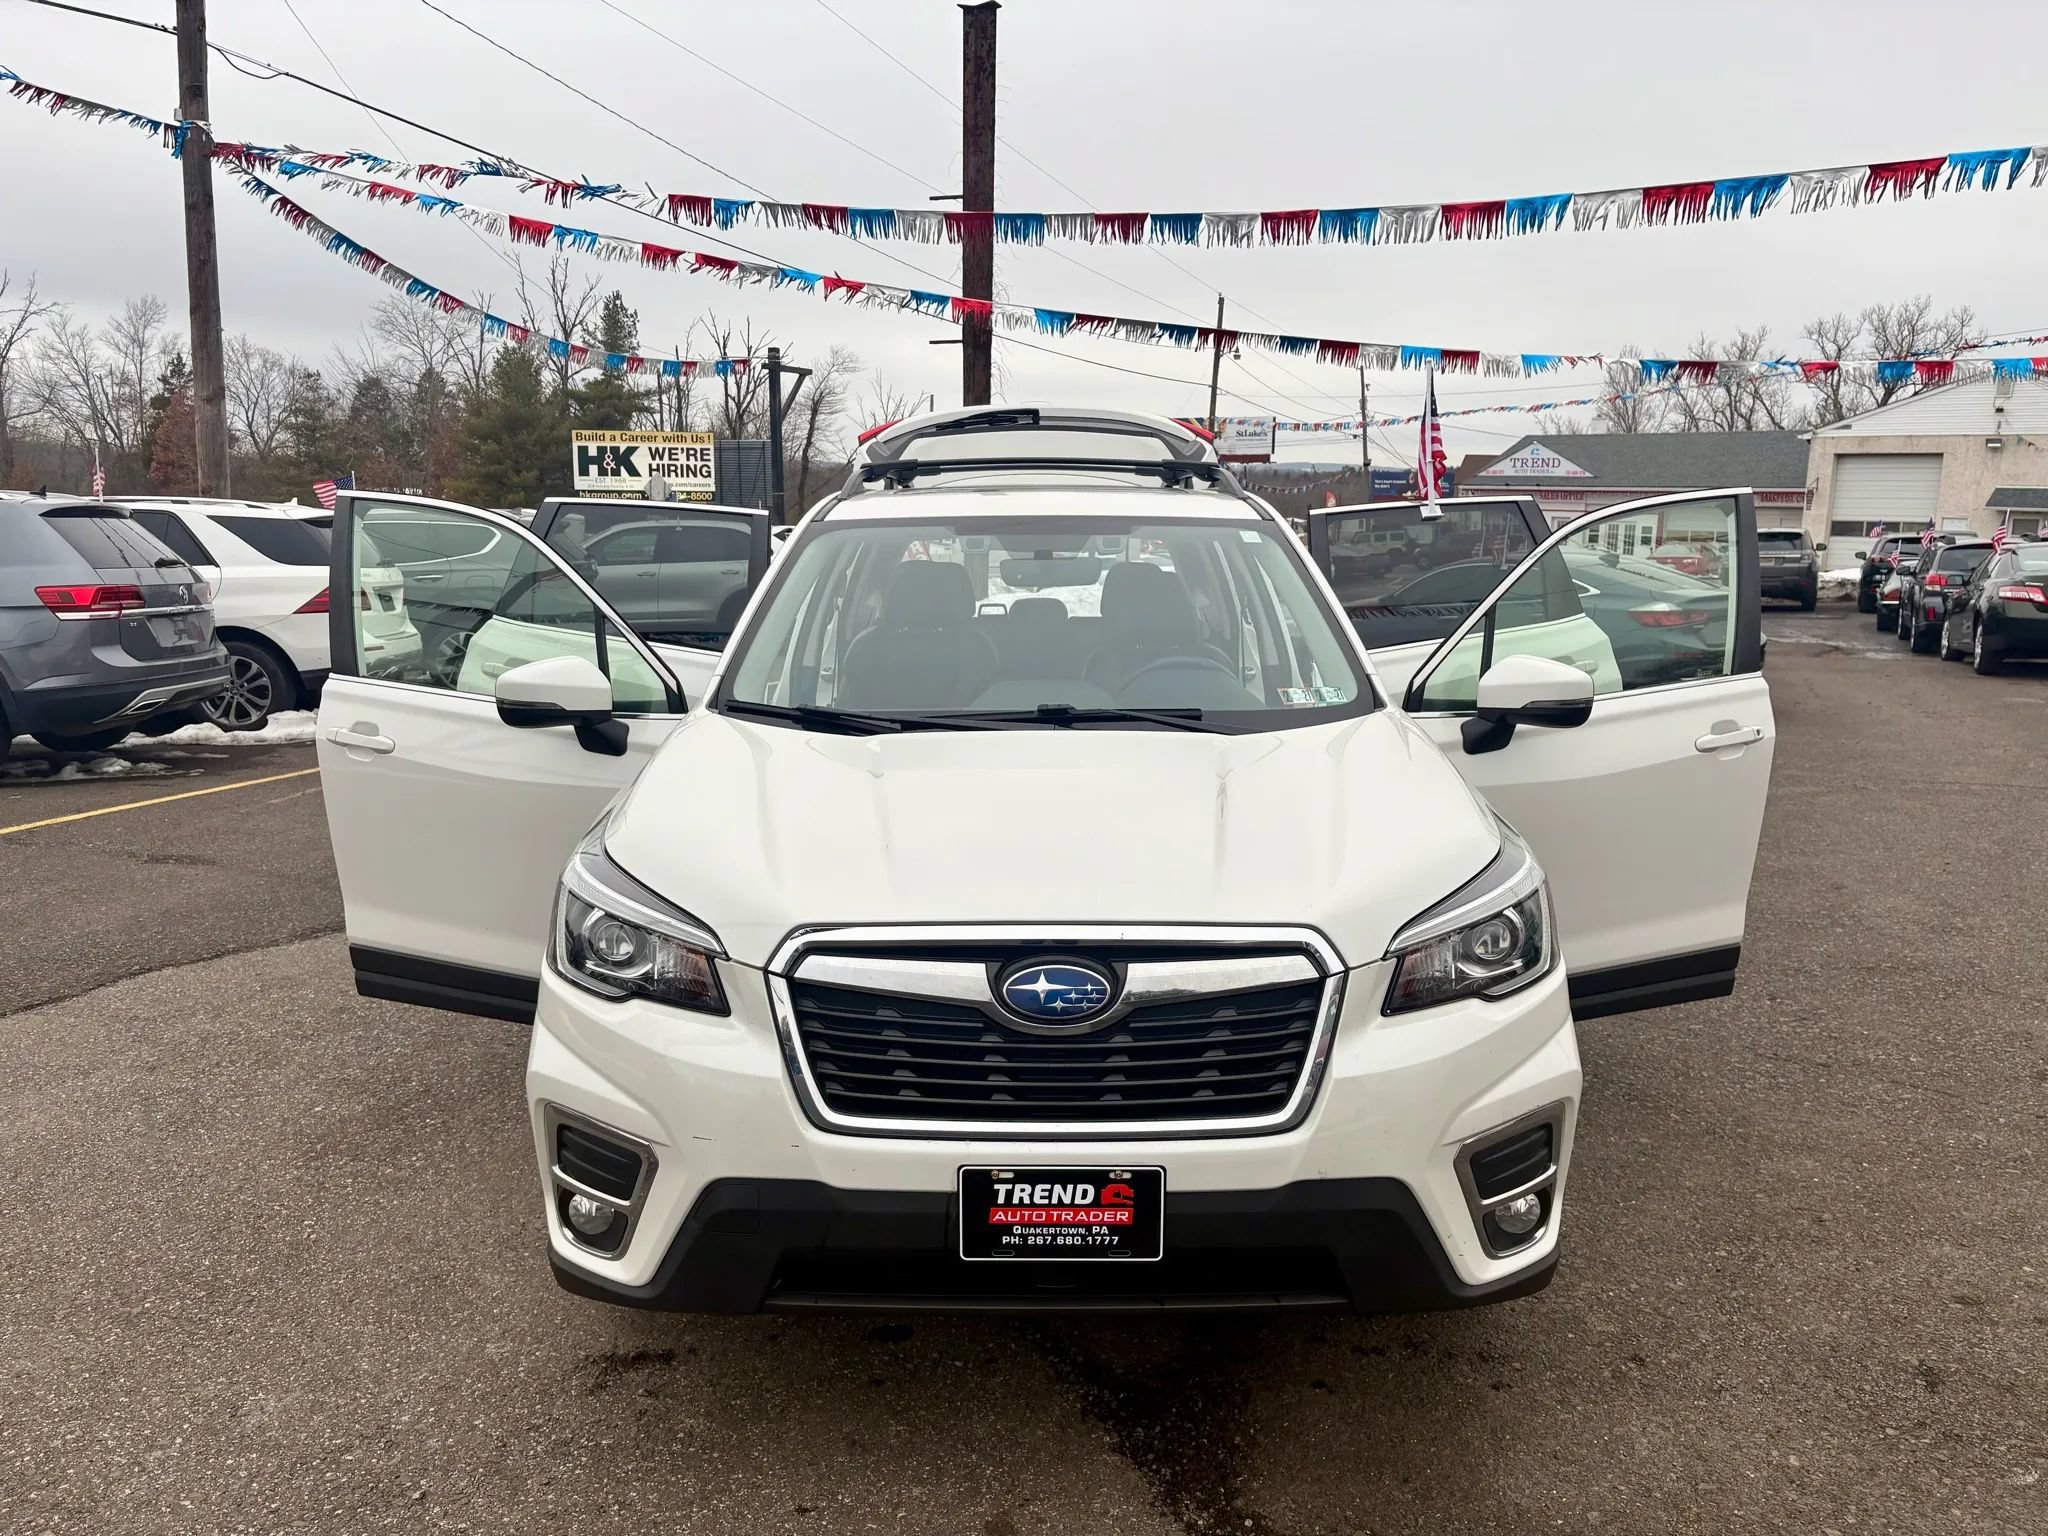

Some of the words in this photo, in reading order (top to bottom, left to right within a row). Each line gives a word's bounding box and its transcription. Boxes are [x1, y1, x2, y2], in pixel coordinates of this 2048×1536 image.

[575, 432, 606, 442] Build
[620, 433, 658, 442] Career
[662, 434, 687, 443] with
[648, 446, 711, 462] WE'RE
[578, 446, 642, 477] H&K
[1510, 457, 1561, 469] TREND
[648, 463, 712, 479] HIRING
[993, 1183, 1095, 1205] TREND
[1092, 1226, 1109, 1235] PA
[1002, 1236, 1024, 1245] PH:
[1027, 1236, 1119, 1245] 267.680.1777
